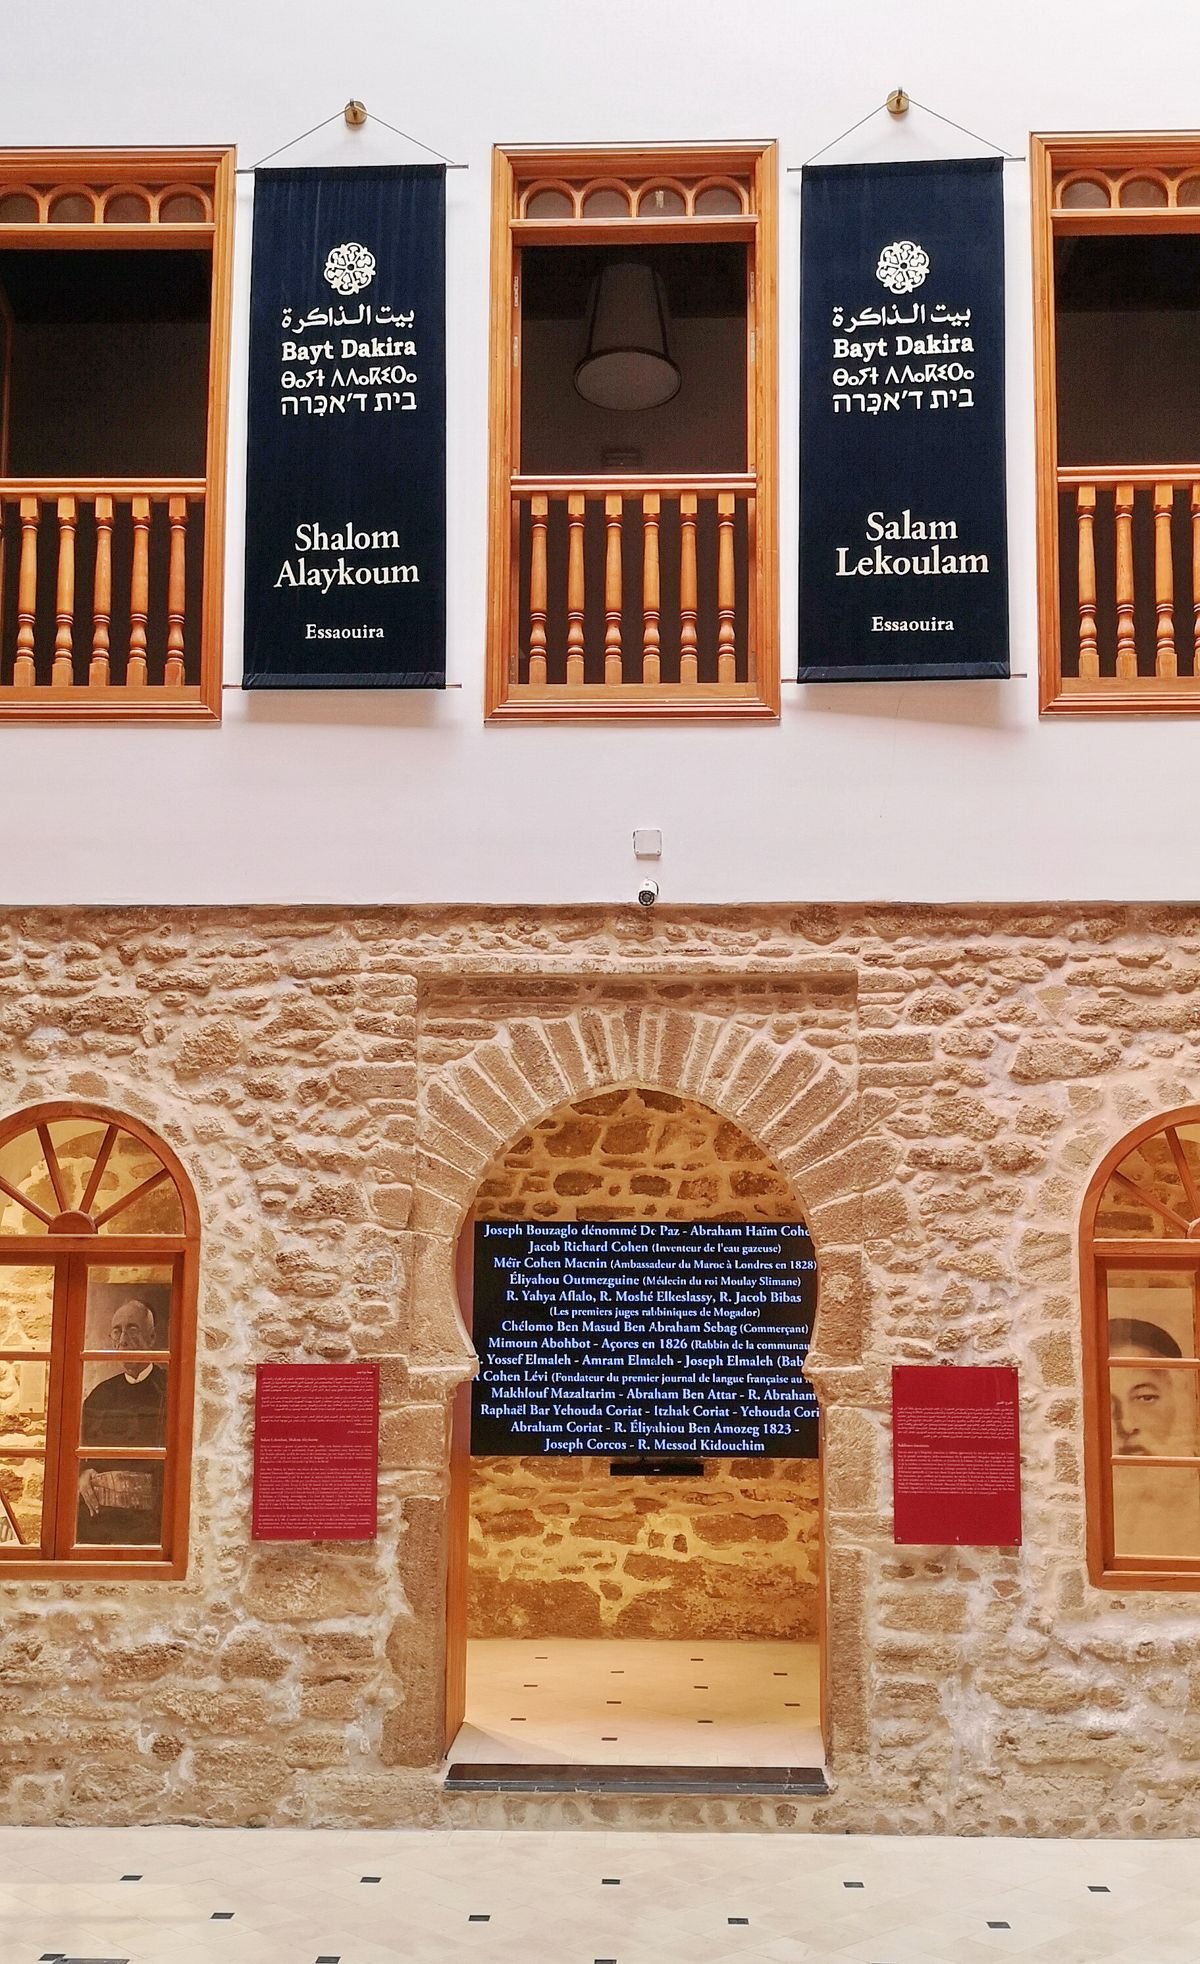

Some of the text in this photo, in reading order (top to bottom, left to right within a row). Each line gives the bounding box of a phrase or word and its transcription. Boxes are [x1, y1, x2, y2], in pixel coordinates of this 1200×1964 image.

[281, 303, 415, 334] بيت الذاكرة
[832, 302, 972, 333] بيت الذاكرة
[281, 336, 417, 365] Bayt Dakira
[832, 333, 975, 363] Bayt Dakira
[373, 391, 418, 412] בית
[929, 388, 975, 410] בית
[865, 509, 959, 541] Salam
[294, 521, 401, 552] Shalom
[835, 544, 990, 577] Lekoulam
[272, 557, 421, 595] Alaykoum
[304, 623, 385, 639] Essaouira
[870, 615, 955, 632] Essaouira
[484, 1224, 523, 1239] Joseph
[526, 1223, 578, 1239] Bouzaglo
[580, 1224, 638, 1236] dénommé
[640, 1224, 657, 1236] De
[659, 1224, 681, 1236] Paz
[689, 1224, 743, 1237] Abraham
[745, 1225, 778, 1237] Haïm
[527, 1240, 782, 1256] Jacob Richard Cohen (Inventeur de l'eau gazeuse)
[493, 1256, 817, 1271] Méïr Cohen Macnin (Ambassadeur du Maroc à Londres en 1828)
[509, 1271, 801, 1289] Éliyahou Outmezguine (Médecin du roi Moulay Slimane)
[506, 1289, 802, 1306] R. Yahya Aflalo, R. Moshé Elkeslassy, R. Jacob Bibas
[549, 1306, 761, 1320] (Les premiers juges rabbiniques de Mogador)
[501, 1319, 809, 1337] Chélomo Ben Masud Ben Abraham Sebag (Commerçant)
[488, 1337, 538, 1349] Mimoun
[540, 1337, 591, 1349] Abohbot
[601, 1337, 640, 1352] Açores
[641, 1341, 655, 1349] en
[660, 1338, 688, 1350] 1826
[690, 1339, 730, 1351] (Rabbin
[731, 1339, 744, 1350] de
[745, 1339, 755, 1350] la
[486, 1353, 524, 1365] Yossef
[525, 1353, 572, 1366] Elmaleh
[581, 1354, 625, 1366] Amram
[627, 1353, 674, 1366] Elmaleh
[683, 1354, 724, 1370] Joseph
[726, 1354, 774, 1367] Elmaleh
[482, 1369, 521, 1382] Cohen
[524, 1370, 548, 1382] Lévi
[551, 1371, 605, 1383] (Fondateur
[606, 1372, 620, 1383] du
[621, 1373, 660, 1386] premier
[661, 1372, 696, 1385] journal
[698, 1372, 711, 1383] de
[712, 1372, 745, 1386] langue
[746, 1372, 789, 1386] française
[790, 1376, 803, 1384] au
[491, 1386, 550, 1399] Makhlouf
[550, 1387, 616, 1399] Mazaltarim
[626, 1387, 679, 1400] Abraham
[682, 1388, 705, 1400] Ben
[707, 1388, 738, 1400] Attar
[748, 1388, 761, 1401] R.
[763, 1388, 817, 1401] Abraham
[480, 1403, 527, 1419] Raphaël
[529, 1404, 551, 1416] Bar
[552, 1403, 603, 1416] Yehouda
[605, 1404, 643, 1417] Coriat
[654, 1404, 690, 1417] Itzhak
[692, 1405, 730, 1417] Coriat
[740, 1405, 791, 1418] Yehouda
[510, 1420, 564, 1433] Abraham
[566, 1421, 604, 1433] Coriat
[614, 1421, 627, 1433] R.
[688, 1422, 711, 1434] Ben
[713, 1422, 760, 1438] Amozeg
[763, 1423, 792, 1435] 1823
[543, 1437, 584, 1453] Joseph
[586, 1438, 627, 1450] Corcos
[637, 1438, 651, 1450] R.
[654, 1438, 697, 1451] Messod
[700, 1438, 765, 1451] Kidouchim
